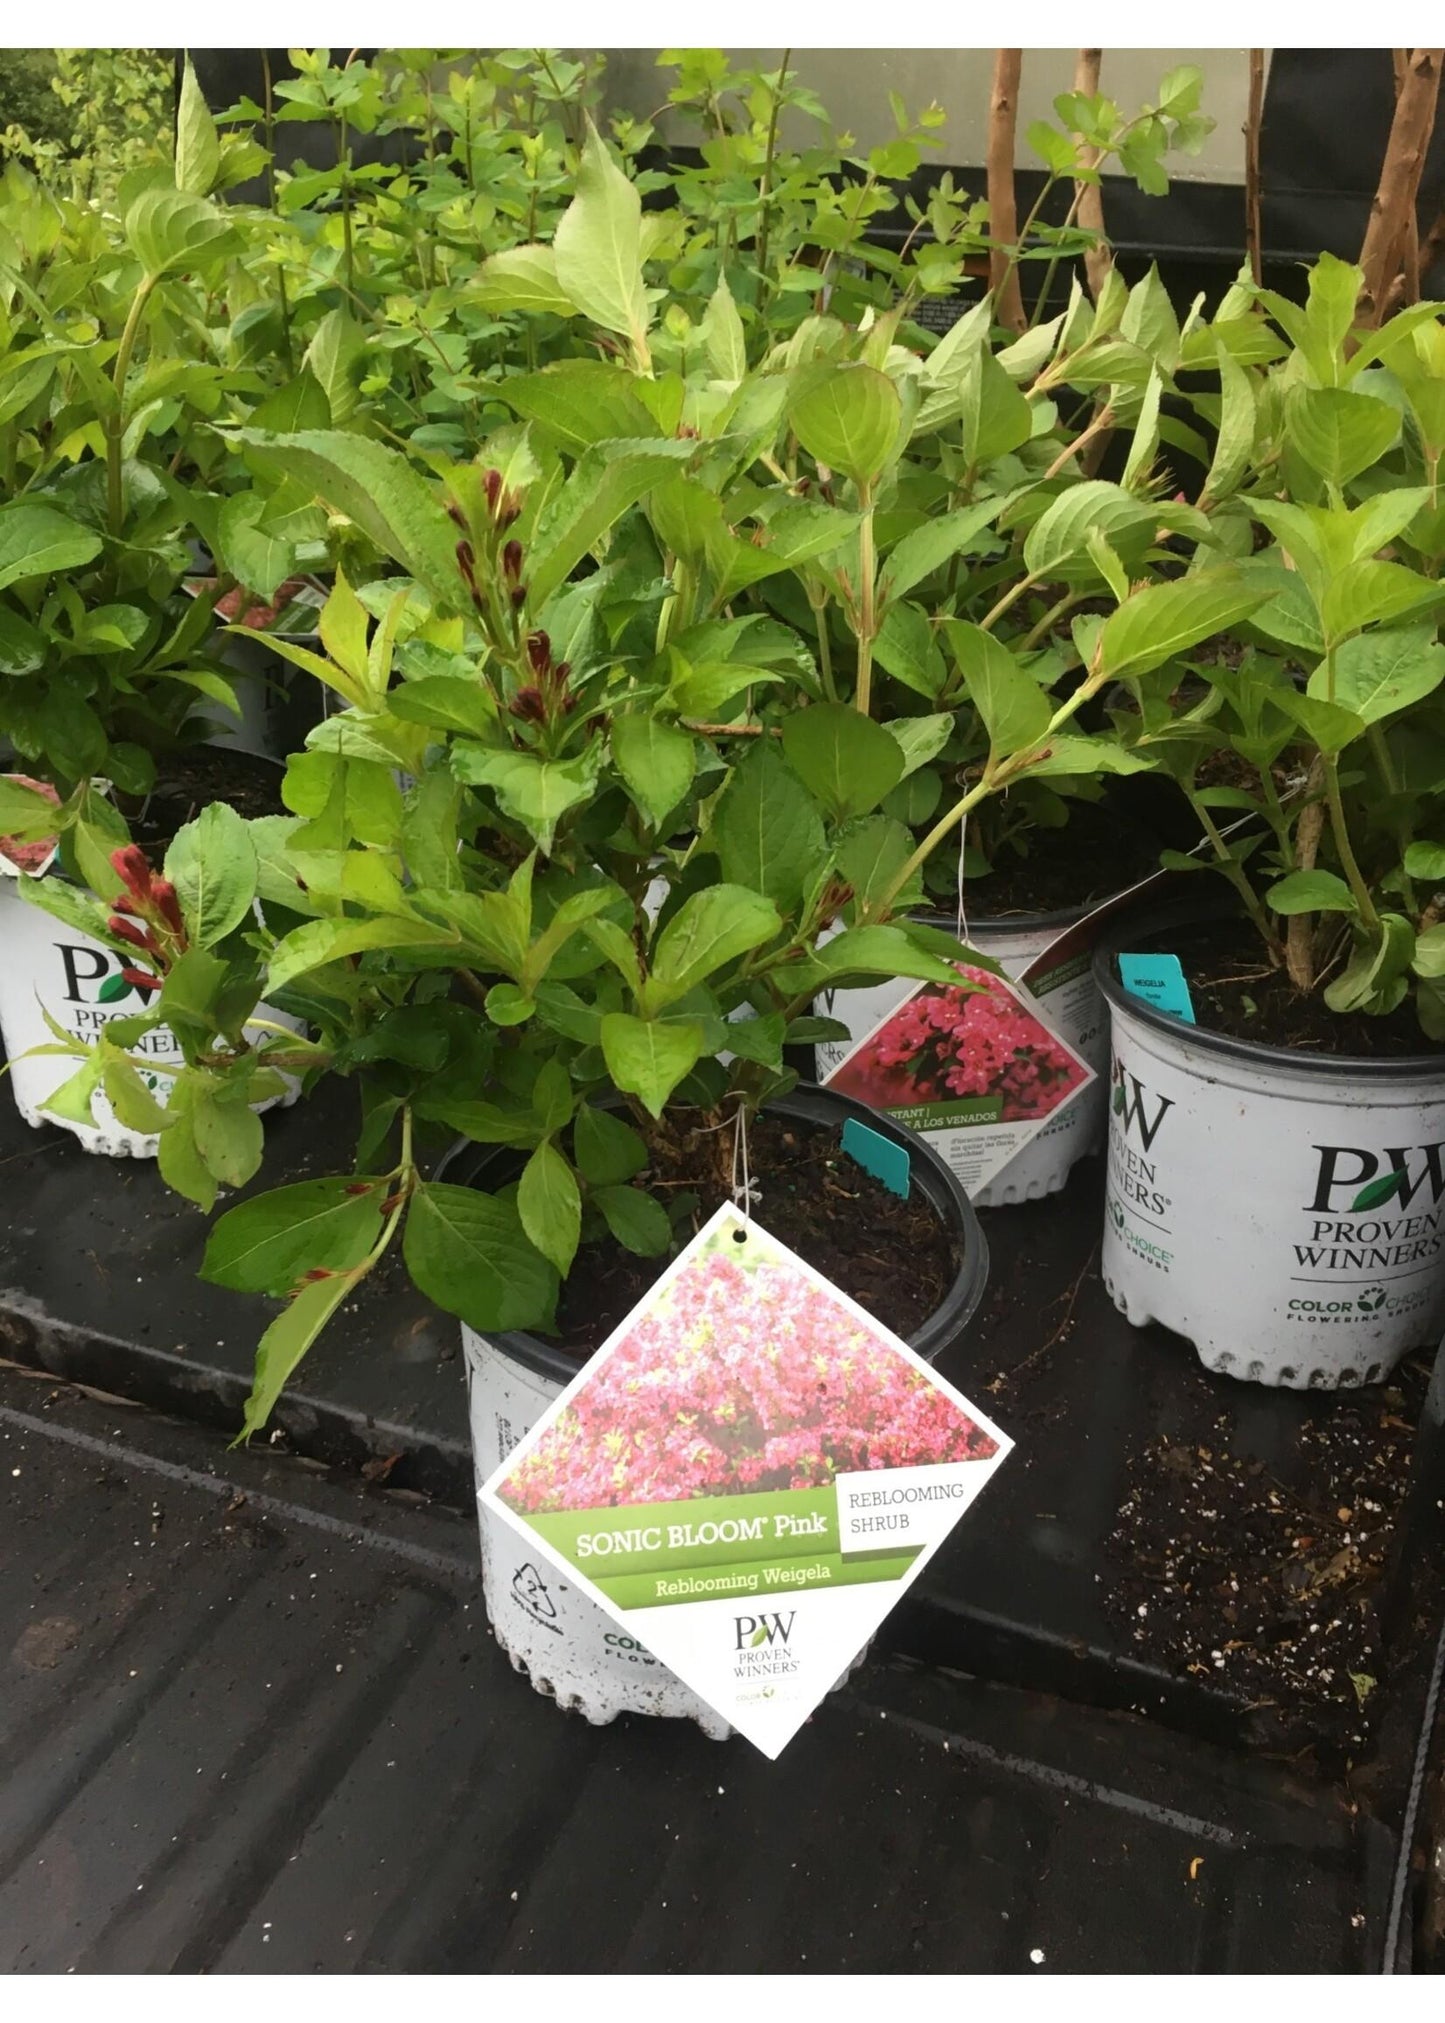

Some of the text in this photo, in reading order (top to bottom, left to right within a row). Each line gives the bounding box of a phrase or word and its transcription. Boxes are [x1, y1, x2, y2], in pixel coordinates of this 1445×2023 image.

[913, 1121, 921, 1130] A
[924, 1117, 945, 1127] LOS
[946, 1111, 998, 1126] VENADOS
[1302, 1141, 1445, 1213] PW
[1310, 1209, 1443, 1244] PROVEN
[1286, 1312, 1380, 1323] FLOWERING
[1288, 1299, 1353, 1313] COLOR
[849, 1484, 963, 1508] REBLOOMING
[577, 1526, 662, 1558] SONIC
[773, 1512, 828, 1538] Pink
[851, 1514, 910, 1534] SHRUB
[656, 1564, 832, 1598] Reblooming Weigela
[733, 1611, 797, 1650] PW
[739, 1648, 792, 1665] PROVEN
